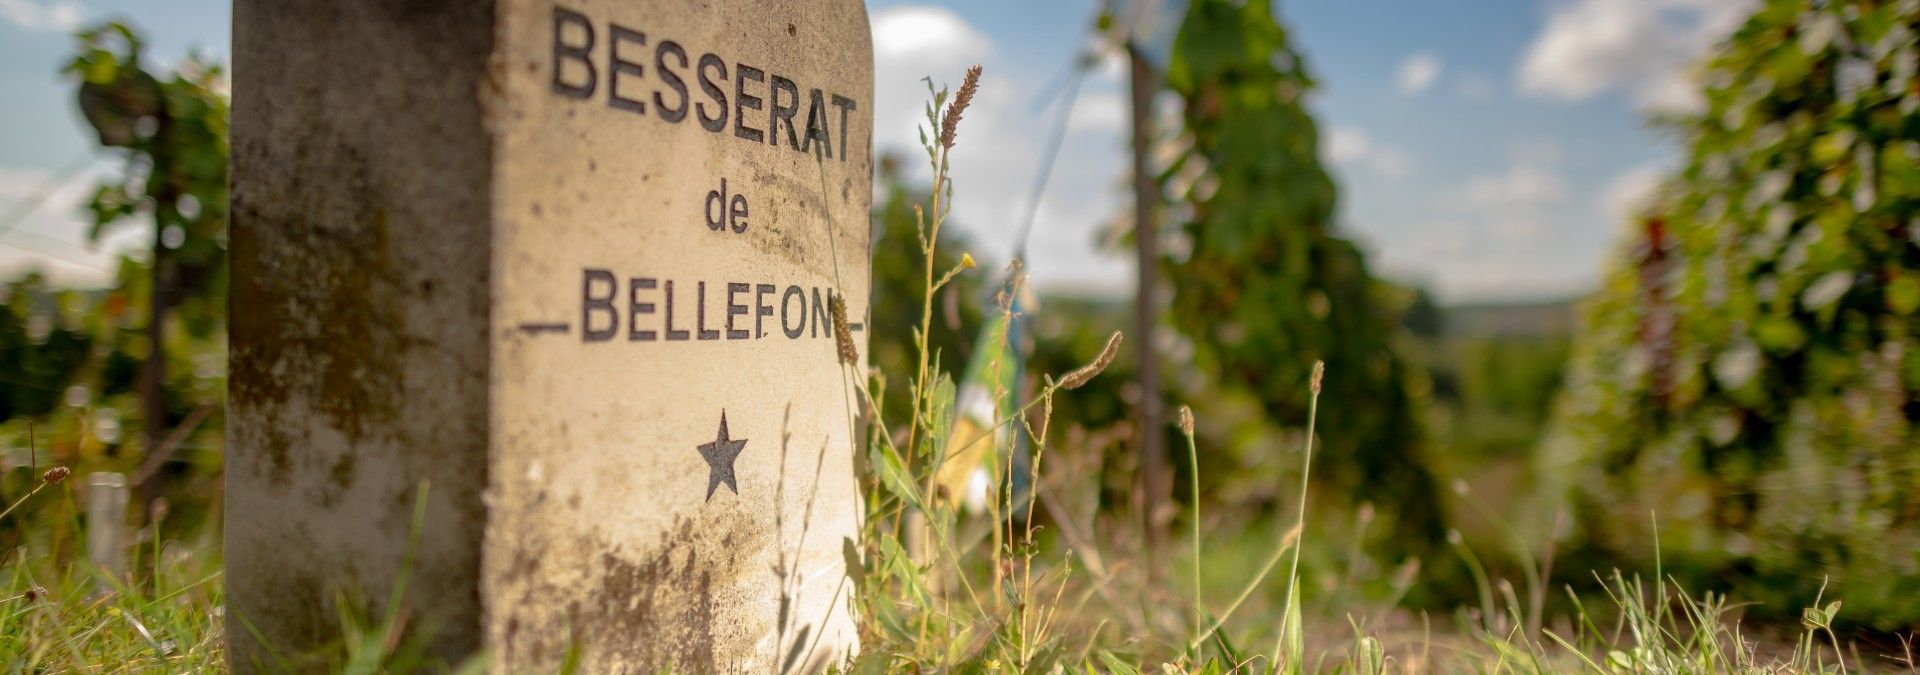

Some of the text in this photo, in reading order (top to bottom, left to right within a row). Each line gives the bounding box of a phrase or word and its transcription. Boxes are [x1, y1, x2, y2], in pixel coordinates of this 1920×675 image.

[551, 7, 857, 162] BESSERAT
[705, 178, 749, 234] de
[581, 267, 833, 343] BELLEFON
